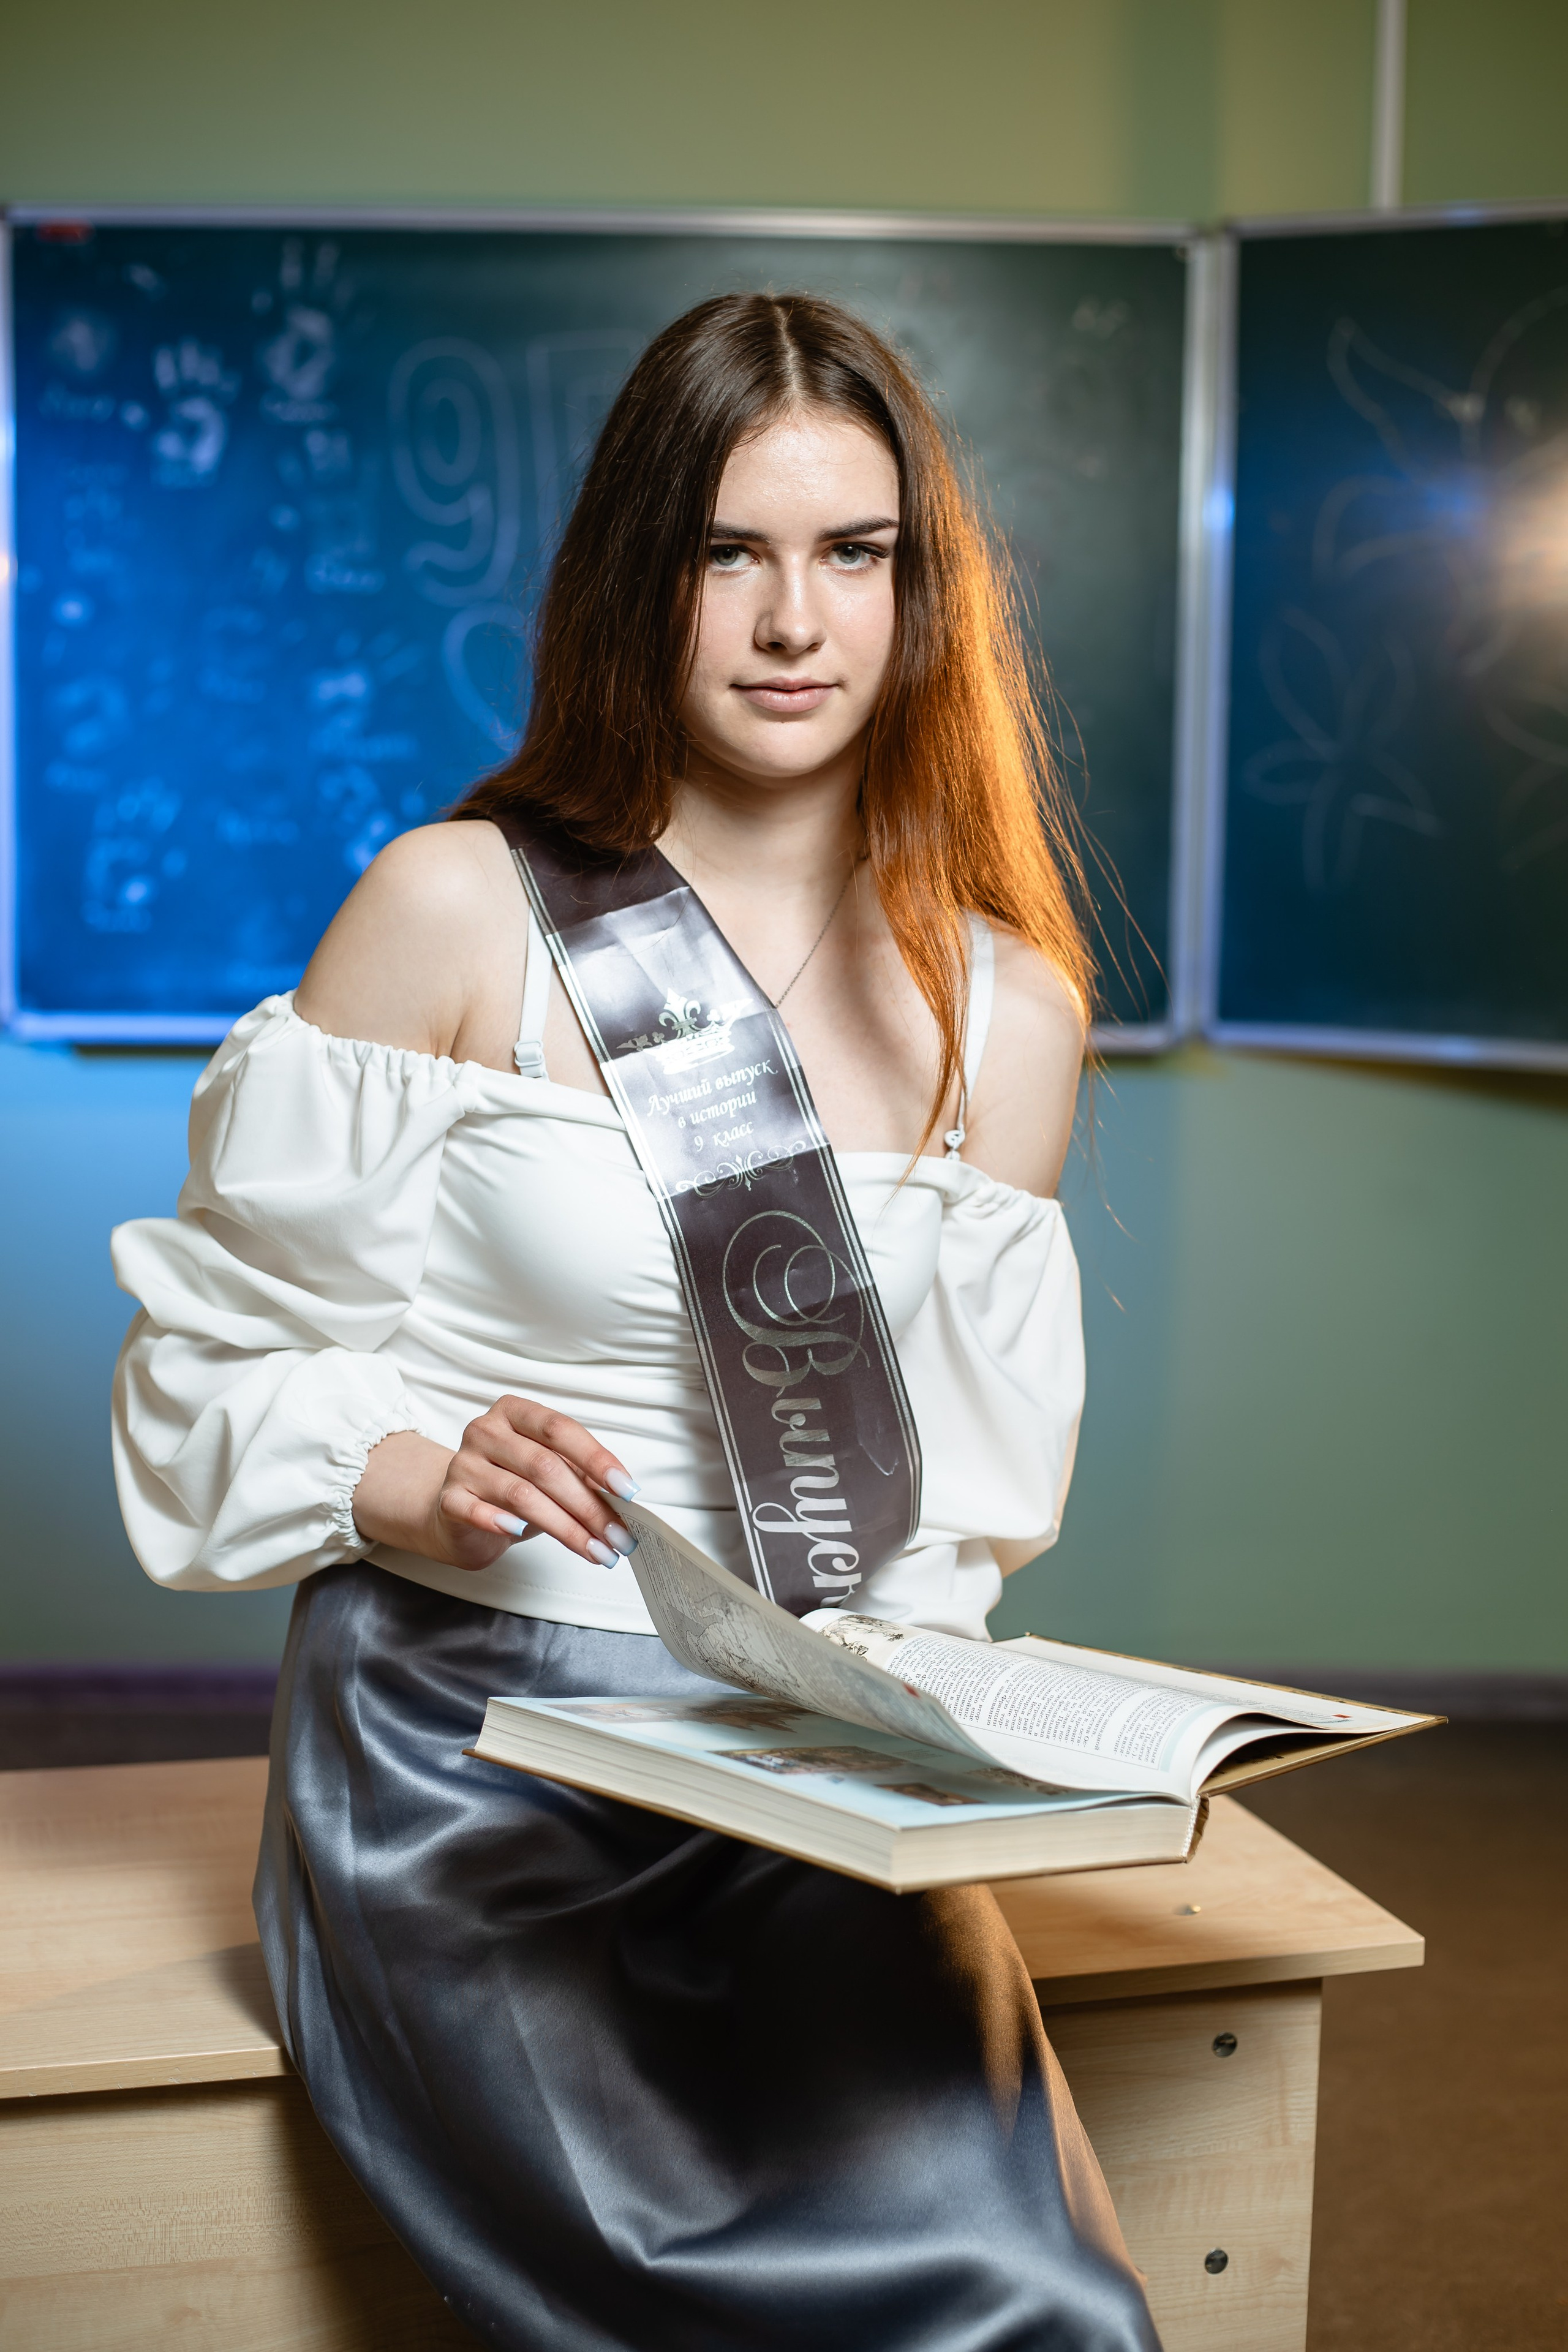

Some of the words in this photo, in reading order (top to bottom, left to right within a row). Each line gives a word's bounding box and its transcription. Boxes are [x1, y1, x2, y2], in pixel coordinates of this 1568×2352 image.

[647, 1078, 713, 1117] Лучший
[715, 1060, 778, 1087] выпуск
[677, 1115, 687, 1129] в
[690, 1091, 757, 1125] истории
[693, 1136, 704, 1152] 9
[713, 1121, 754, 1147] класс
[907, 1658, 917, 1669] тыс.
[919, 1656, 932, 1669] суда.
[924, 1660, 936, 1673] флот
[927, 1667, 937, 1679] был
[952, 1667, 965, 1681] Карл
[967, 1668, 978, 1678] свое
[952, 1668, 970, 1693] началось
[971, 1662, 1000, 1693] непрерывные
[980, 1666, 1010, 1702] французскому
[983, 1670, 997, 1684] начал
[1005, 1683, 1013, 1693] для
[1019, 1683, 1028, 1692] что
[1025, 1684, 1034, 1694] под
[951, 1679, 968, 1717] намерение.
[958, 1688, 970, 1718] позволи-
[973, 1687, 984, 1703] было
[987, 1686, 1005, 1725] завоеванию
[1007, 1693, 1020, 1716] крайне
[1027, 1701, 1037, 1716] Весь
[1061, 1700, 1071, 1713] дей.
[992, 1695, 1006, 1727] Франции
[1009, 1695, 1026, 1730] контролем
[1028, 1703, 1042, 1735] отраслям
[1036, 1695, 1054, 1727] промысла
[1040, 1690, 1065, 1737] стимулировала
[1046, 1700, 1065, 1739] феодальная
[1061, 1710, 1071, 1728] главе
[1070, 1710, 1080, 1722] был
[1085, 1713, 1098, 1733] состав
[1091, 1702, 1114, 1737] континента.
[1052, 1716, 1063, 1740] Правя-
[1070, 1717, 1082, 1744] провин-
[1114, 1724, 1127, 1754] источни-
[1125, 1723, 1140, 1757] дневника,
[1138, 1733, 1152, 1760] Палаты
[1145, 1731, 1159, 1762] Конгресс
